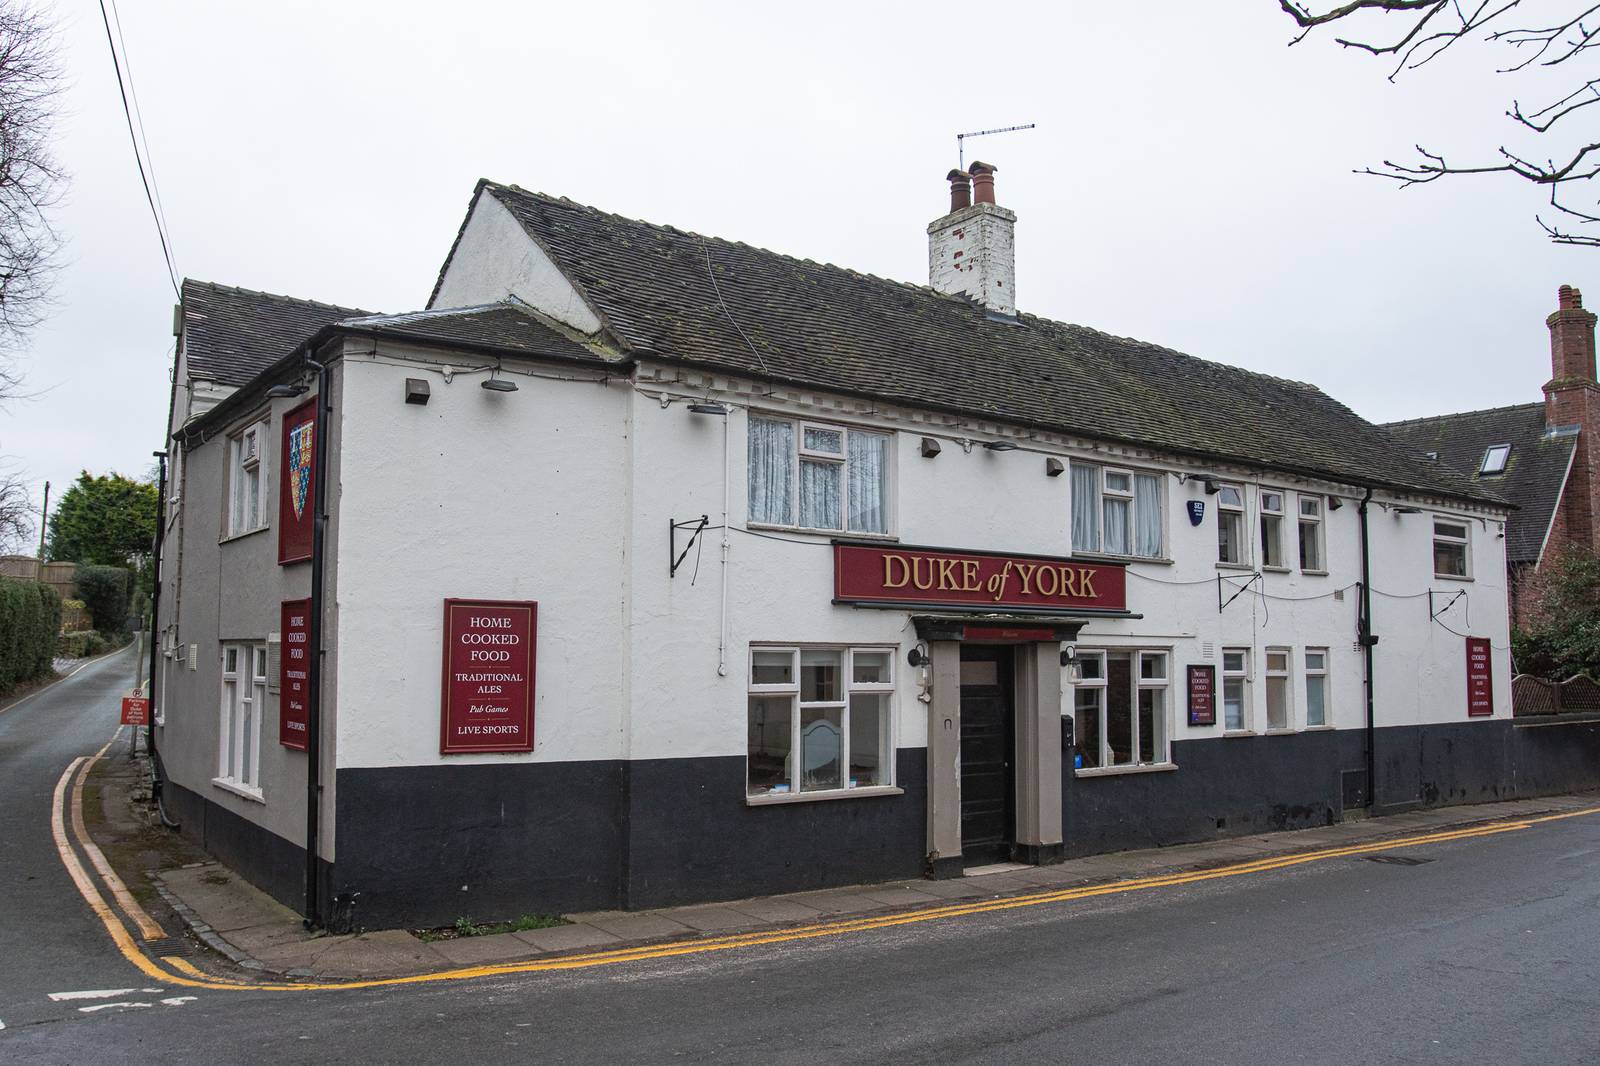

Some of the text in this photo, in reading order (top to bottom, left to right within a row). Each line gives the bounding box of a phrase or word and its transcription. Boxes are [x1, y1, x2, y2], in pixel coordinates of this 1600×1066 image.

[882, 554, 1098, 601] DUKE of YORK
[470, 617, 512, 628] HOME
[461, 633, 519, 645] COOKED
[471, 650, 510, 661] FOOD
[455, 673, 523, 682] TRADITIONAL
[477, 685, 502, 694] ALES
[469, 705, 509, 713] Pub Games
[458, 725, 519, 736] LIVE SPORTS
